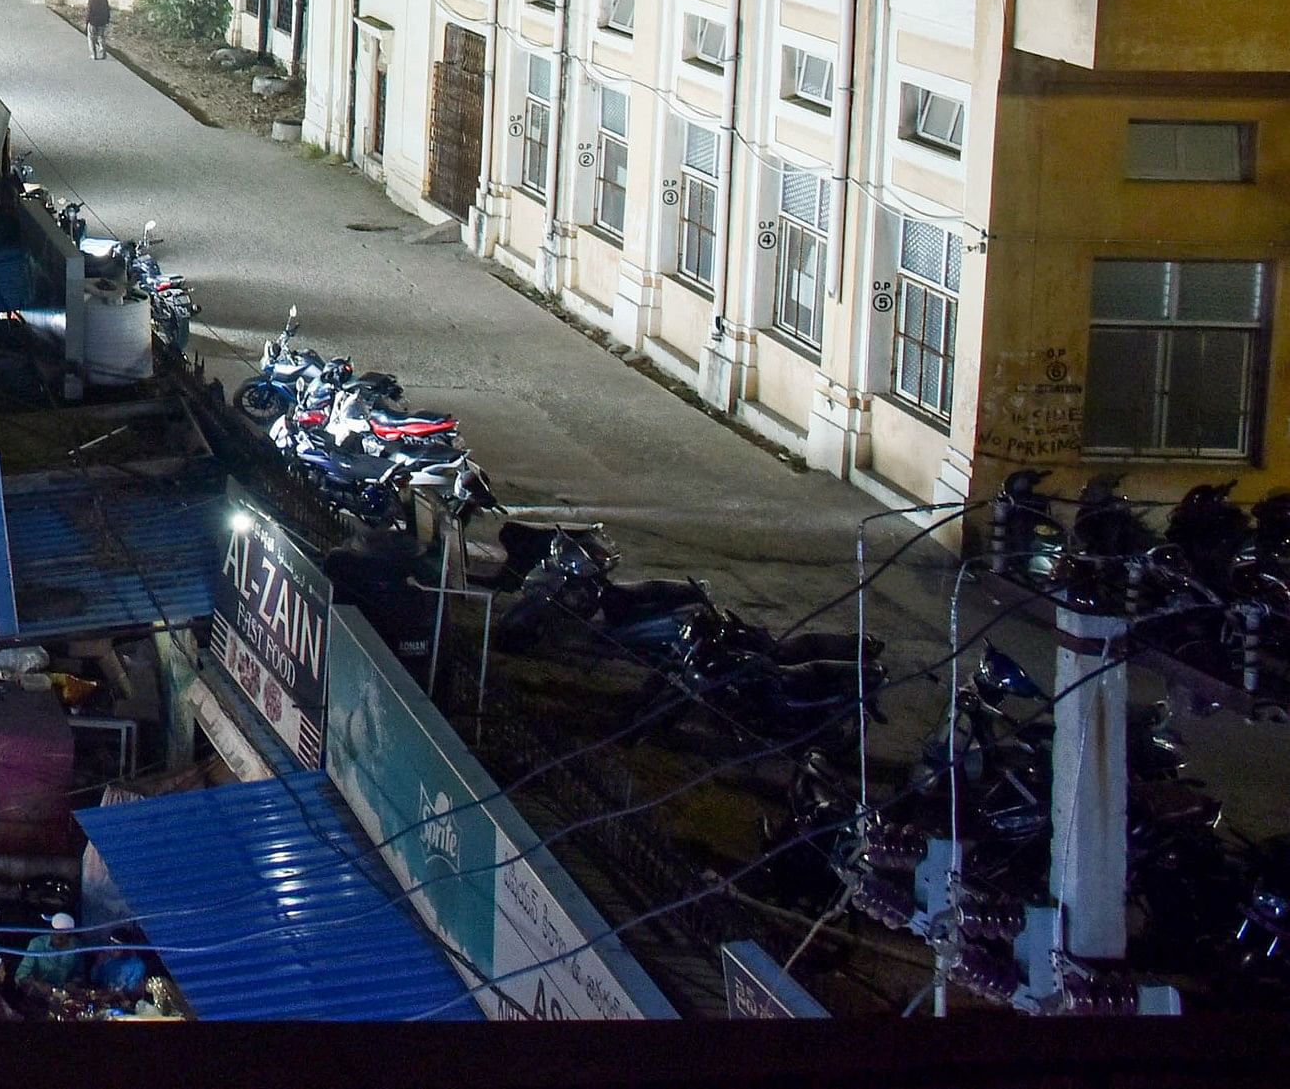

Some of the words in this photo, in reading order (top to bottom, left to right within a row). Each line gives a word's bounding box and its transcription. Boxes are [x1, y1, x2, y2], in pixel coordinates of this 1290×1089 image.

[223, 530, 322, 681] AL-ZAIN
[268, 634, 296, 689] FOOD
[421, 800, 458, 858] Sprite
